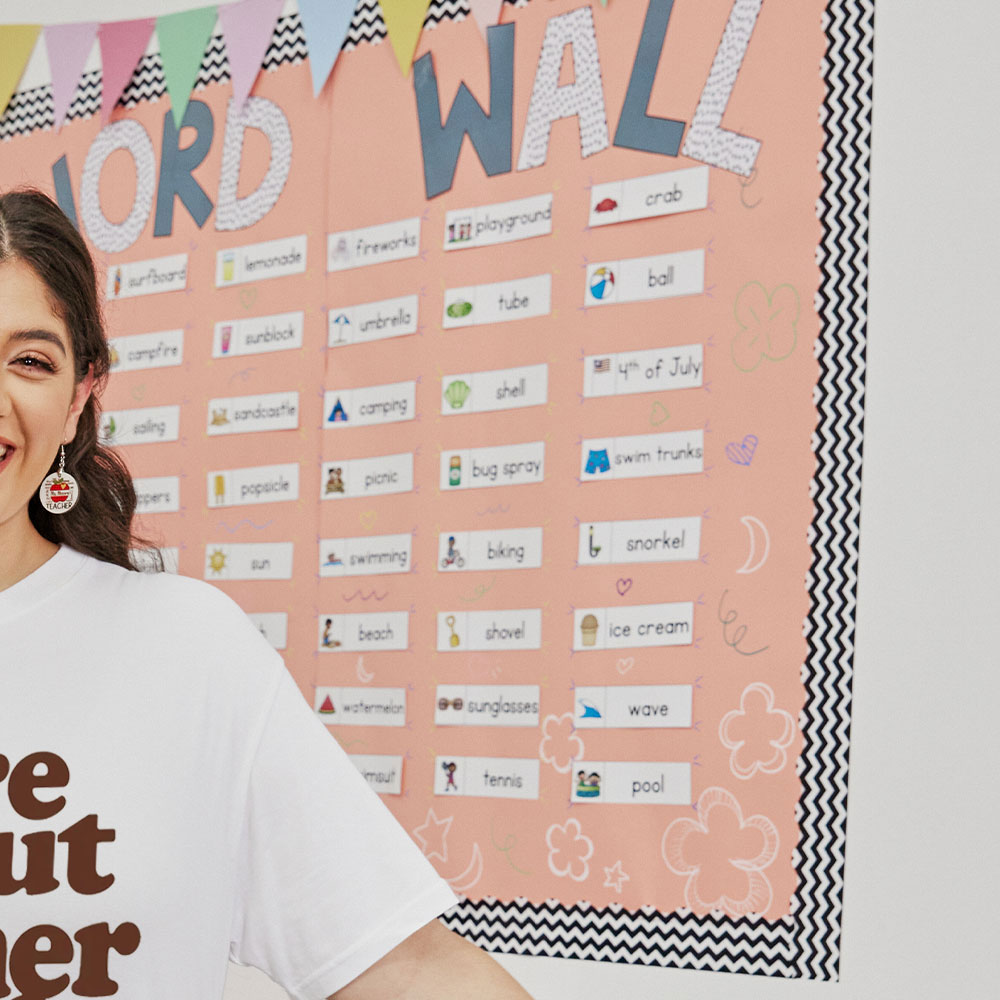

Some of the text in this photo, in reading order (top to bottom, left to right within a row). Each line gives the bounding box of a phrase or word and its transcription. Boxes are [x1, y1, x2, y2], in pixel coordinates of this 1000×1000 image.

[413, 0, 763, 200] WALL
[646, 184, 683, 206] crab
[476, 204, 552, 236] playground
[356, 234, 417, 257] fireworks
[244, 251, 302, 271] lemonade
[128, 268, 187, 288] surfboard
[648, 265, 675, 287] ball
[499, 291, 529, 311] tube
[360, 309, 411, 333] umbrella
[245, 326, 295, 346] sunblock
[128, 343, 178, 363] campfire
[619, 357, 701, 380] 4th of July
[496, 379, 526, 399] shell
[235, 402, 295, 421] sandcastle
[360, 397, 408, 418] camping
[133, 419, 166, 437] sailing
[615, 442, 702, 465] swim trunks
[365, 470, 398, 488] picnic
[473, 459, 541, 480] bug spray
[241, 474, 290, 497] popsicle
[627, 530, 685, 551] snorkel
[350, 549, 408, 568] swimming
[488, 542, 524, 563] biking
[251, 558, 271, 571] sun
[358, 623, 393, 641] beach
[486, 621, 525, 641] shovel
[609, 620, 690, 638] ice cream
[343, 700, 404, 715] watermelon
[467, 695, 539, 718] sunglasses
[628, 703, 669, 717] wave
[363, 767, 397, 785] imsuit
[483, 770, 523, 789] tennis
[632, 775, 665, 797] pool
